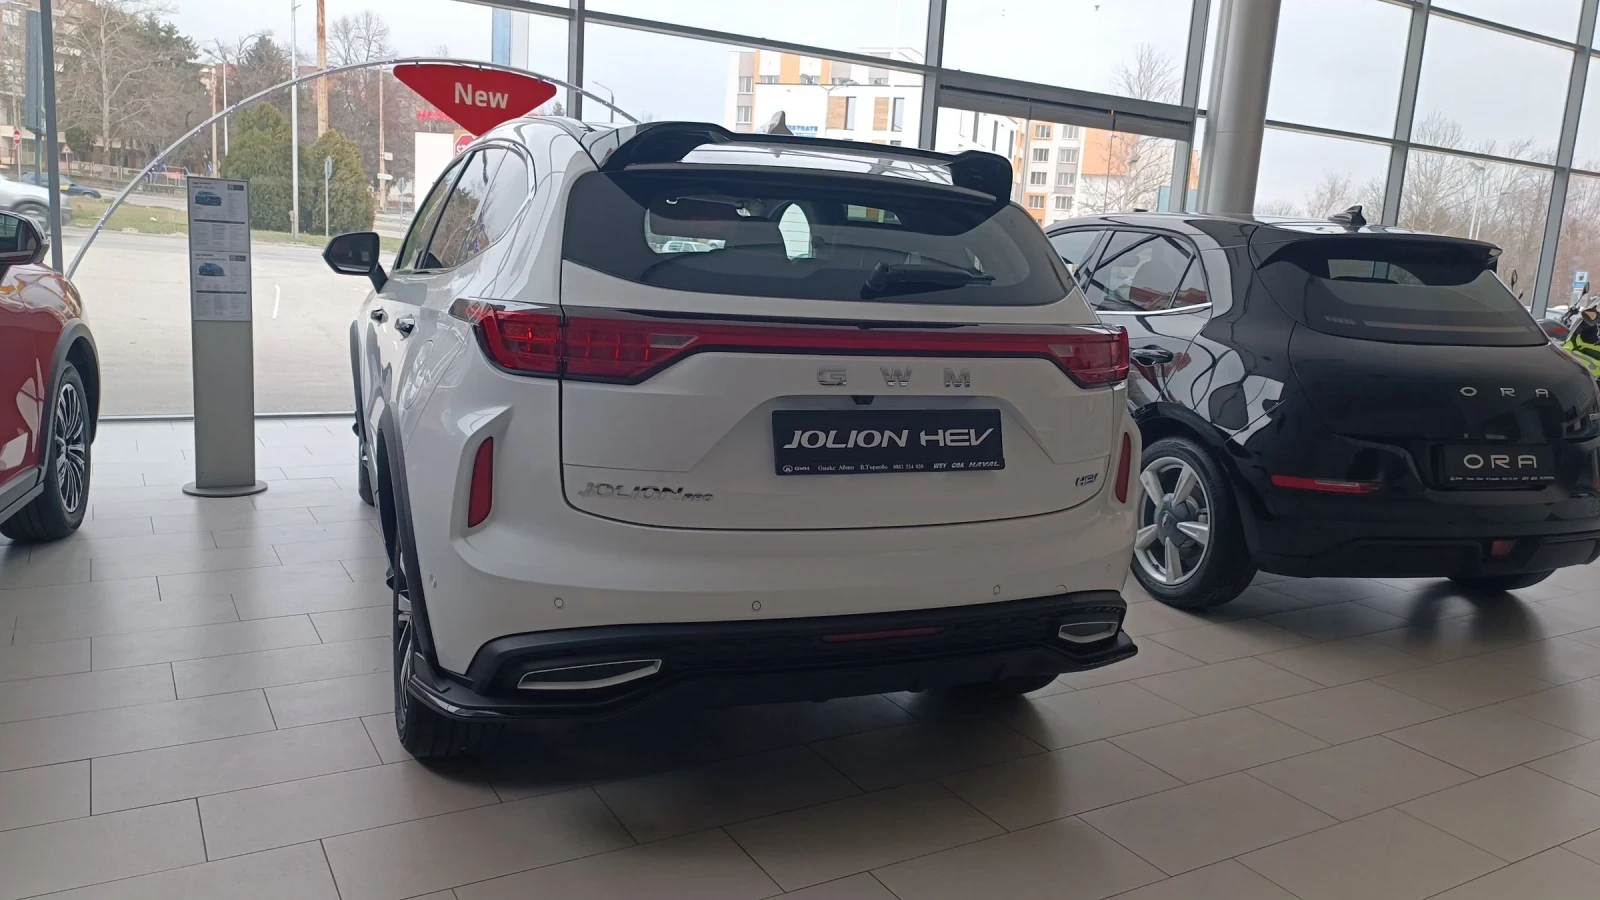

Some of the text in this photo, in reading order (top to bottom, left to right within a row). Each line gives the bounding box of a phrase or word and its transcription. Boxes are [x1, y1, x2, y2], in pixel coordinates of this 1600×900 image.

[454, 82, 508, 109] New
[816, 366, 971, 388] GWM
[1460, 386, 1549, 398] ORA
[783, 428, 994, 449] JOLION HEV
[1463, 453, 1537, 469] ORA
[577, 482, 684, 500] JOLION
